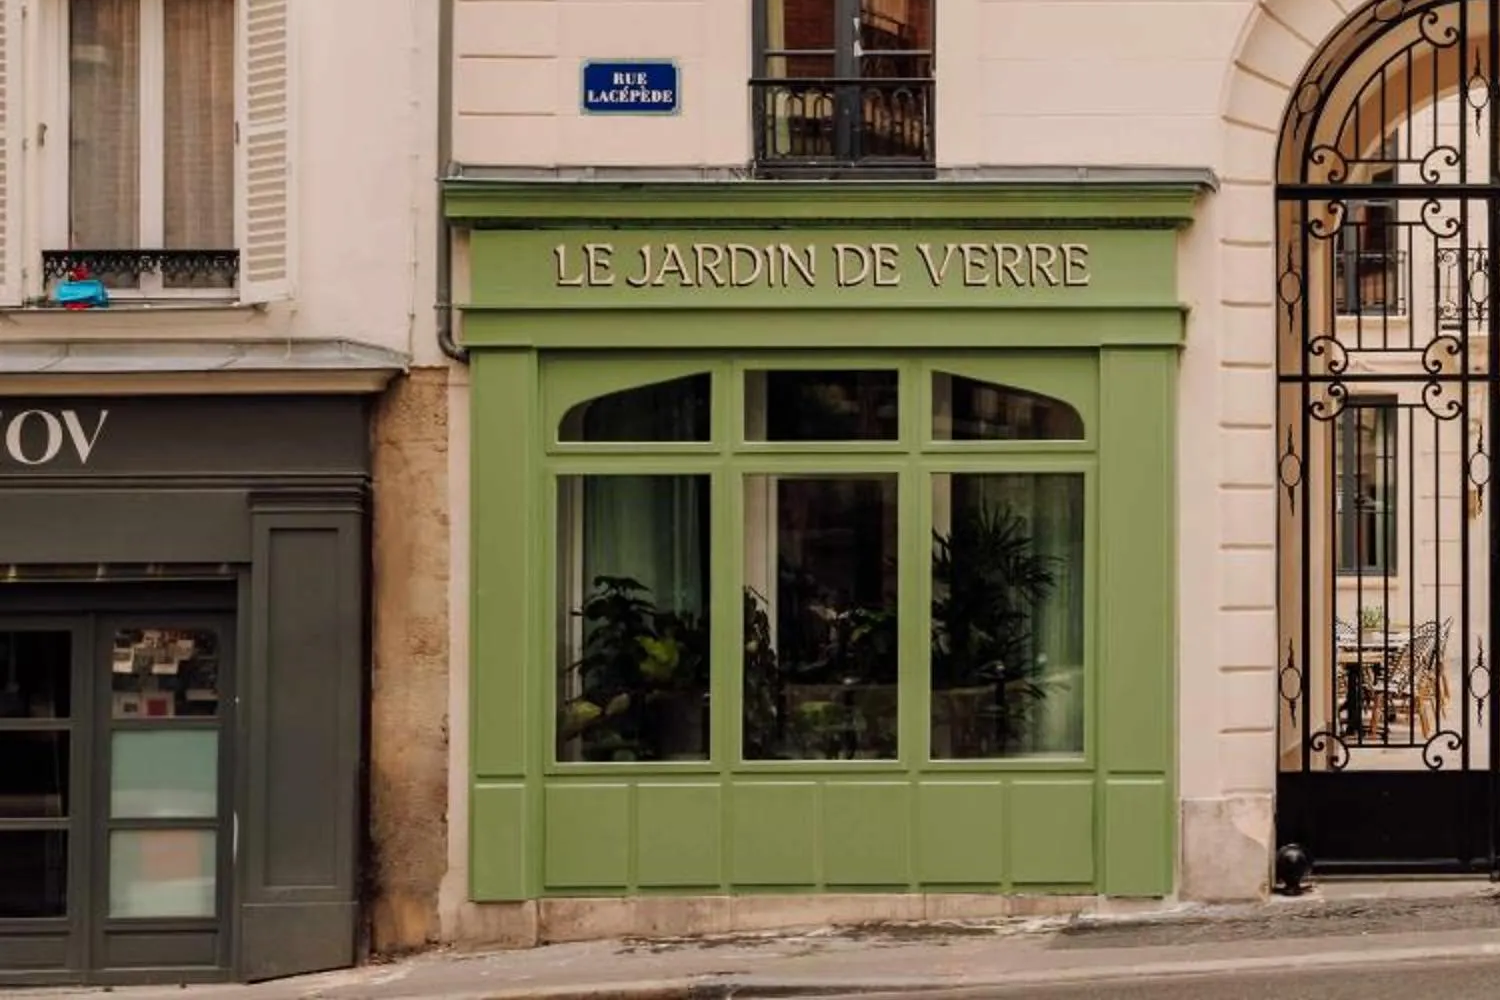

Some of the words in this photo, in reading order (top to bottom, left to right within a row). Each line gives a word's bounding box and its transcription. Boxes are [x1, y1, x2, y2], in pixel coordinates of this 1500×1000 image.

[613, 72, 648, 85] RUE
[588, 86, 673, 103] LACÉPÈDE
[553, 243, 616, 287] LE
[626, 243, 816, 287] JARDIN
[832, 243, 902, 287] DE
[916, 243, 1092, 287] VERRE
[0, 410, 108, 465] OV
